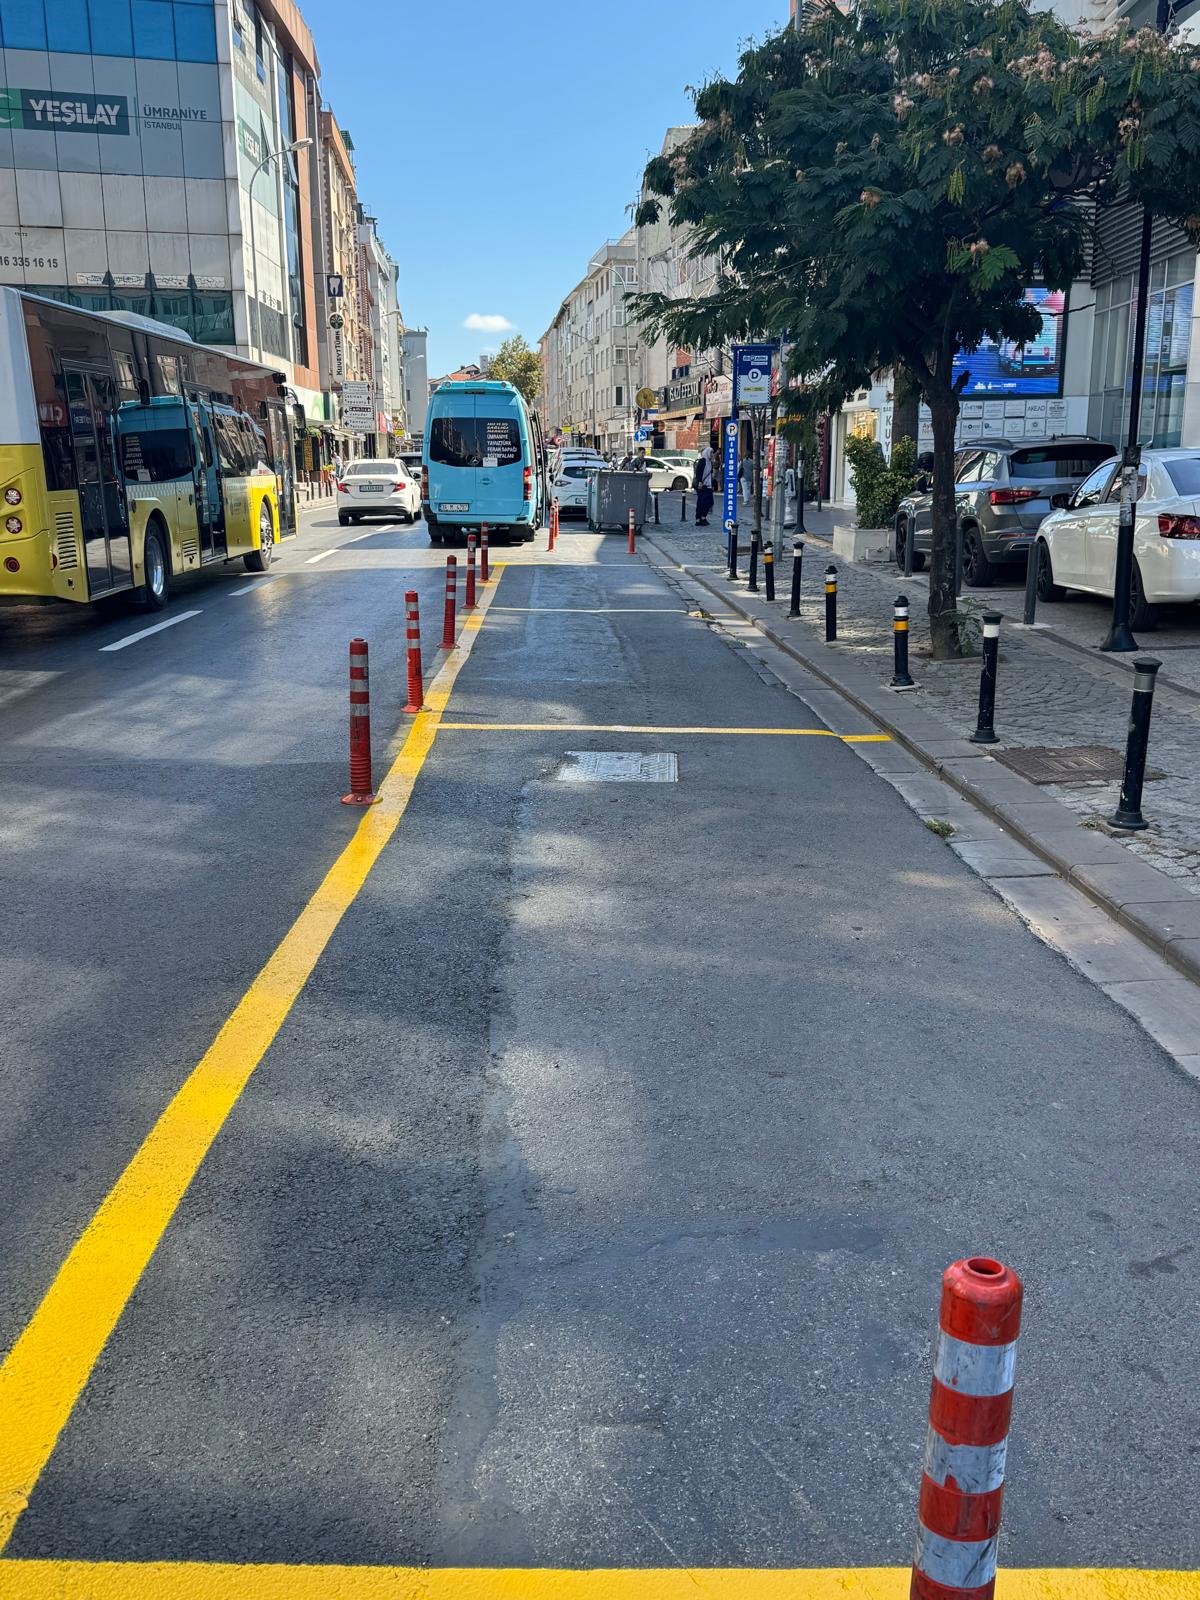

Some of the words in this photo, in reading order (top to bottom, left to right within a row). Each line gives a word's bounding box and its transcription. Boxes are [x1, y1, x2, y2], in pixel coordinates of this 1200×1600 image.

[29, 98, 120, 126] YEŞİLAY
[143, 104, 207, 120] ÜMRANİYE
[144, 119, 182, 130] İSTANBUL
[12, 256, 31, 267] 335
[33, 257, 44, 268] 16
[47, 258, 58, 268] 15
